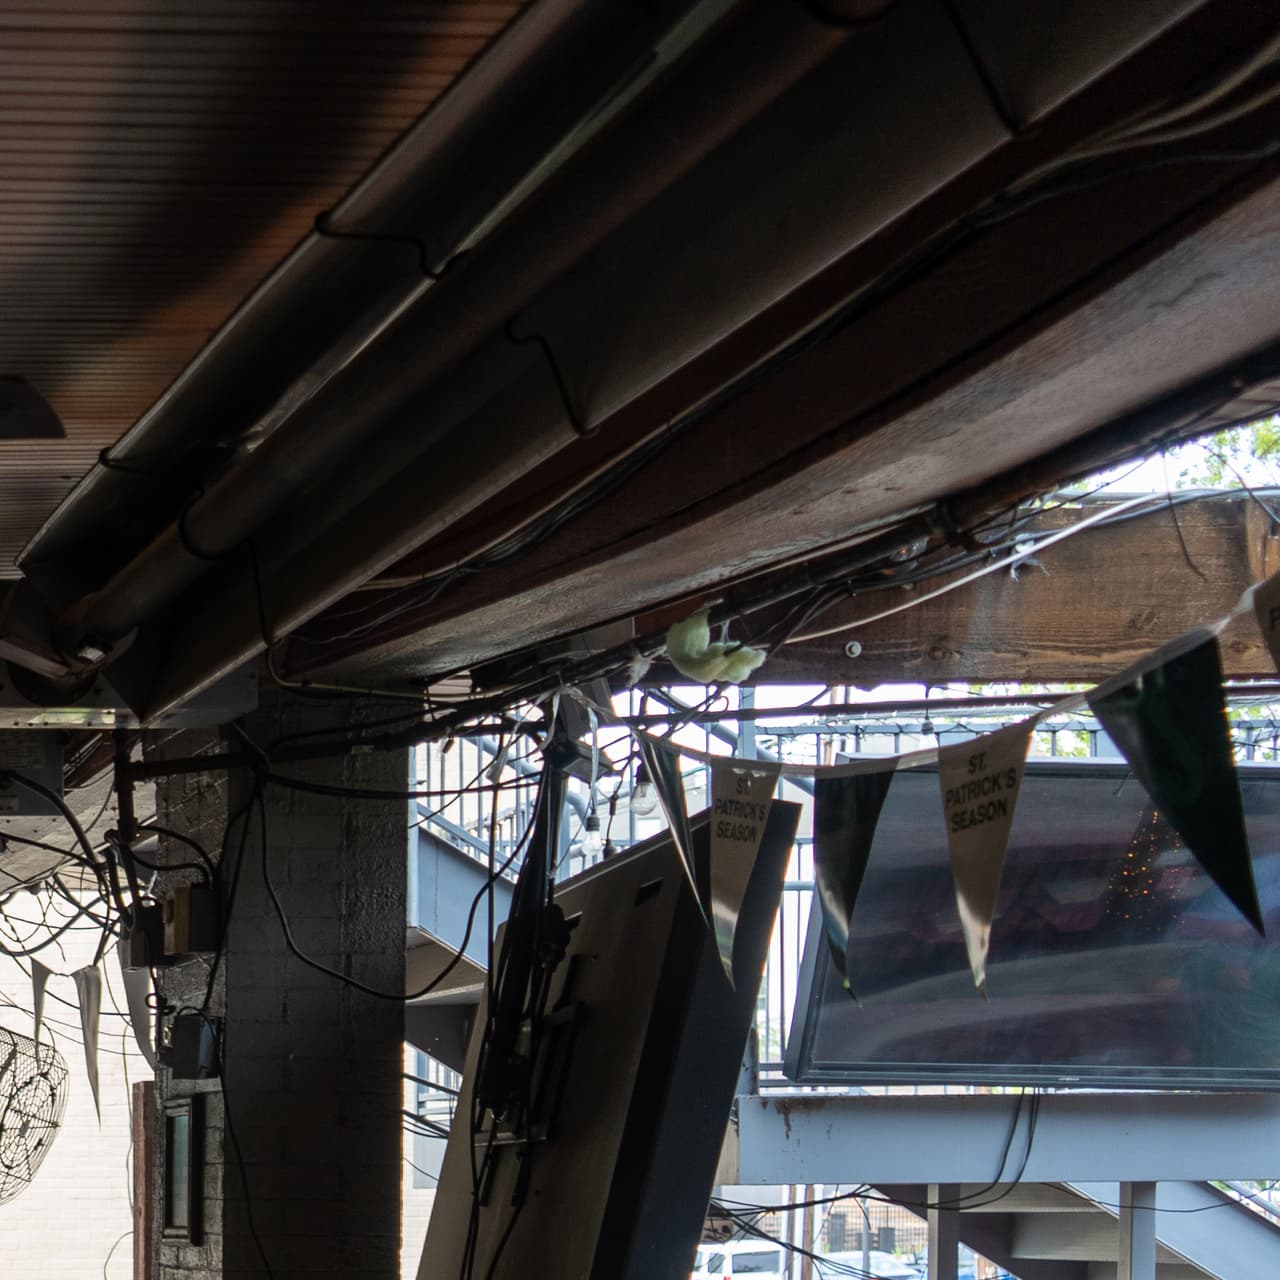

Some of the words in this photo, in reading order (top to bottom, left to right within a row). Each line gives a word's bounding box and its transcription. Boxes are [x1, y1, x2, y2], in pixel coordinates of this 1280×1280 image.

[945, 767, 1017, 808] PATRICK'S
[716, 819, 757, 843] SEASON
[951, 797, 1008, 833] SEASON
